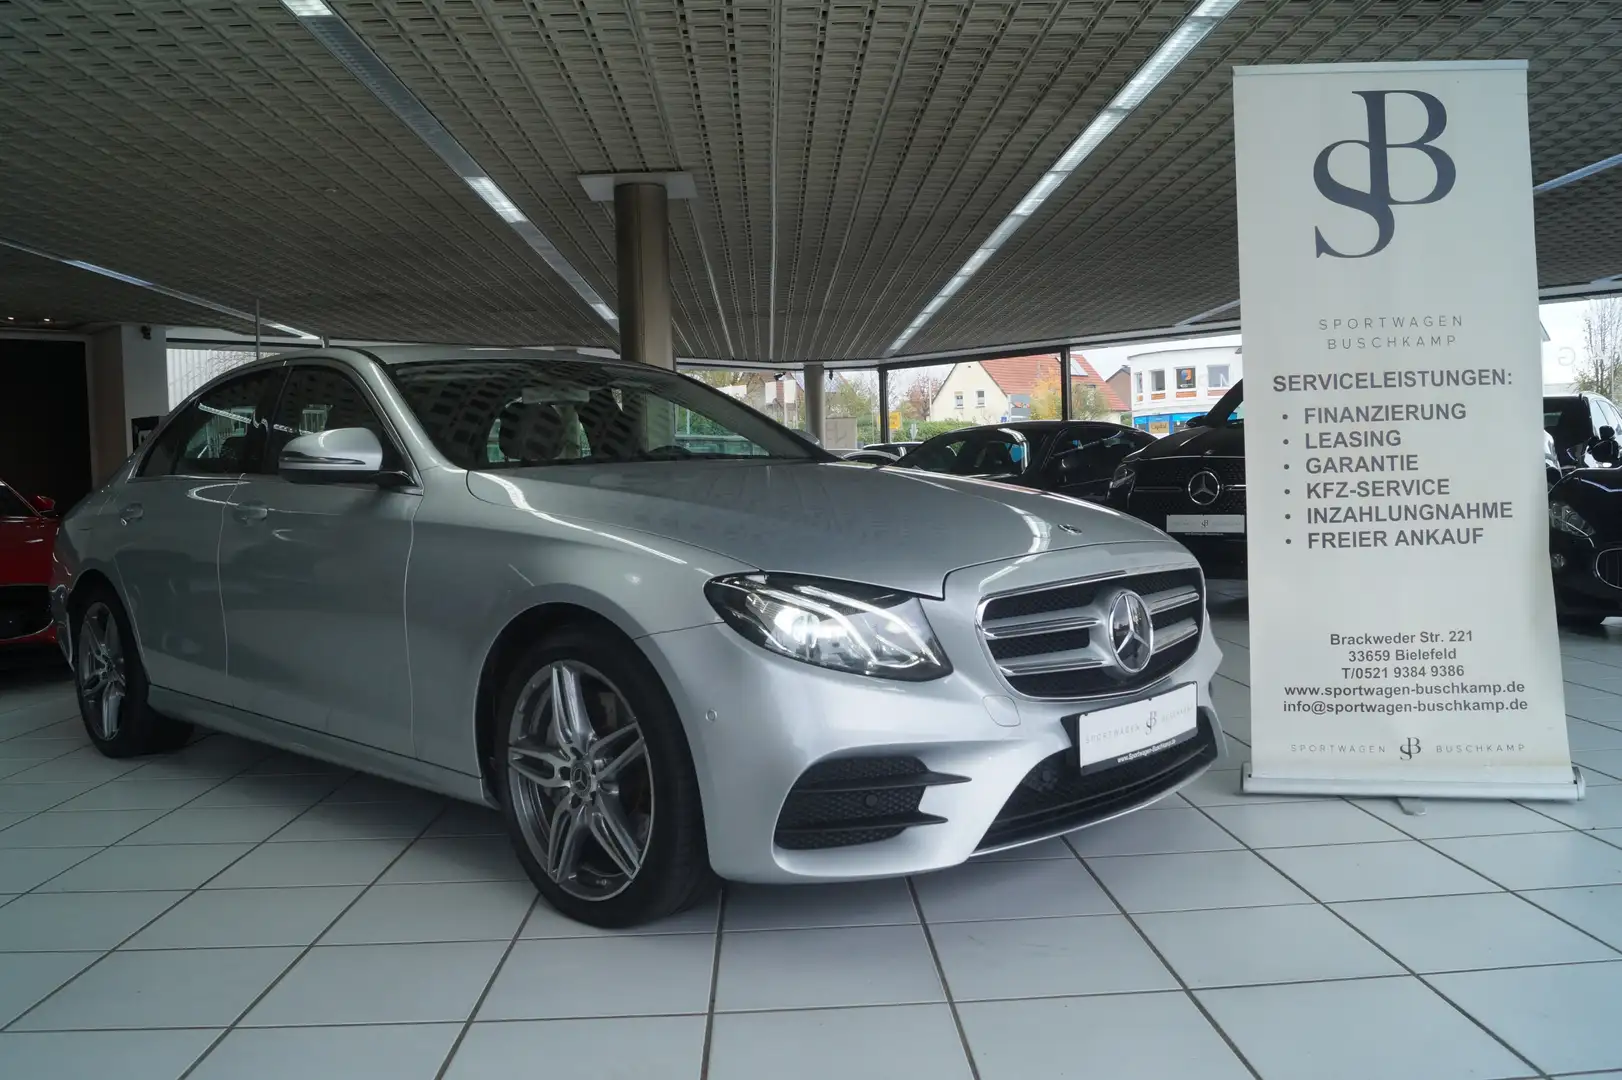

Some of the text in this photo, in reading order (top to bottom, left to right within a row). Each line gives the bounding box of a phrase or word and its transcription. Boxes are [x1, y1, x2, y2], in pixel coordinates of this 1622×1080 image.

[1319, 315, 1461, 330] SPORTWAGEN
[1327, 335, 1455, 349] BUSCHKAMP
[1273, 369, 1512, 392] SERVICELEISTUNGEN:
[1305, 403, 1466, 424] FINANZIERUNG
[1306, 430, 1401, 449] LEASING
[1306, 454, 1418, 474] GARANTIE
[1307, 479, 1450, 499] KFZ-SERVICE
[1308, 502, 1513, 524] INZAHLUNGNAHME
[1308, 528, 1484, 549] FREIER ANKAUF
[1330, 630, 1474, 646] Brackweder Str. 221
[1349, 648, 1457, 662] 33659 Bielefeld
[1341, 665, 1464, 680] T/0521 9384 9386
[1284, 681, 1526, 697] www.sportwagen-buschkamp.de
[1283, 698, 1528, 716] info@sportwagen-buschkamp.de
[1291, 744, 1385, 753] SPORTWAGEN
[1436, 743, 1525, 753] BUSCHKAMP
